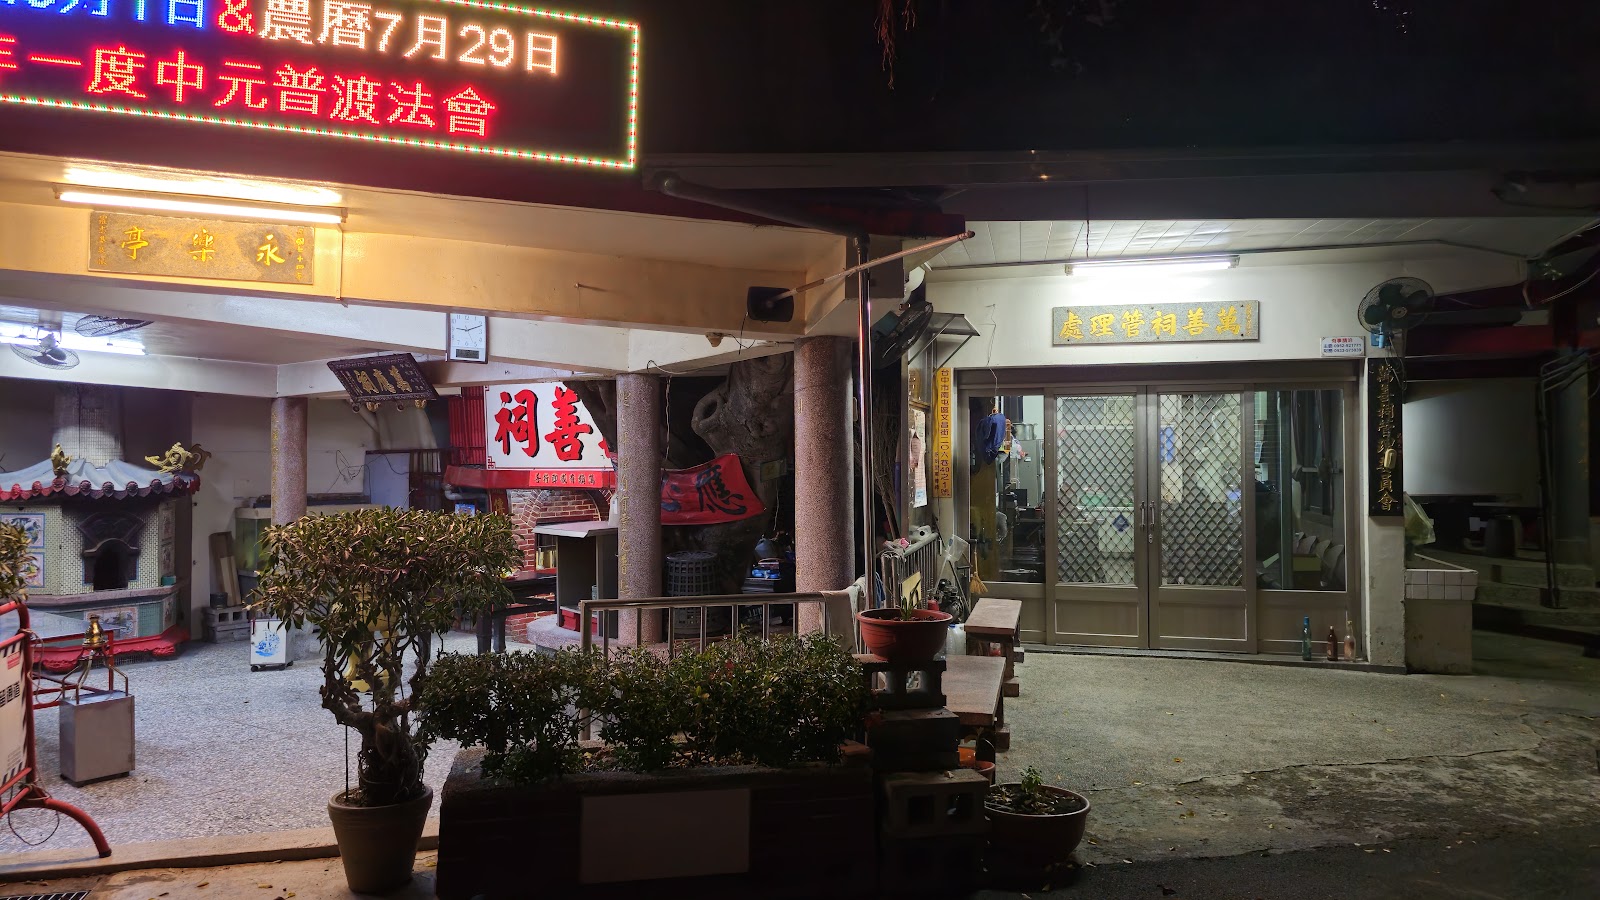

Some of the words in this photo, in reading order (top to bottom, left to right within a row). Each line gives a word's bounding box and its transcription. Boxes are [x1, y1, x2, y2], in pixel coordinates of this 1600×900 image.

[1059, 305, 1241, 340] 萬善祠管理處
[494, 385, 611, 461] 善祠
